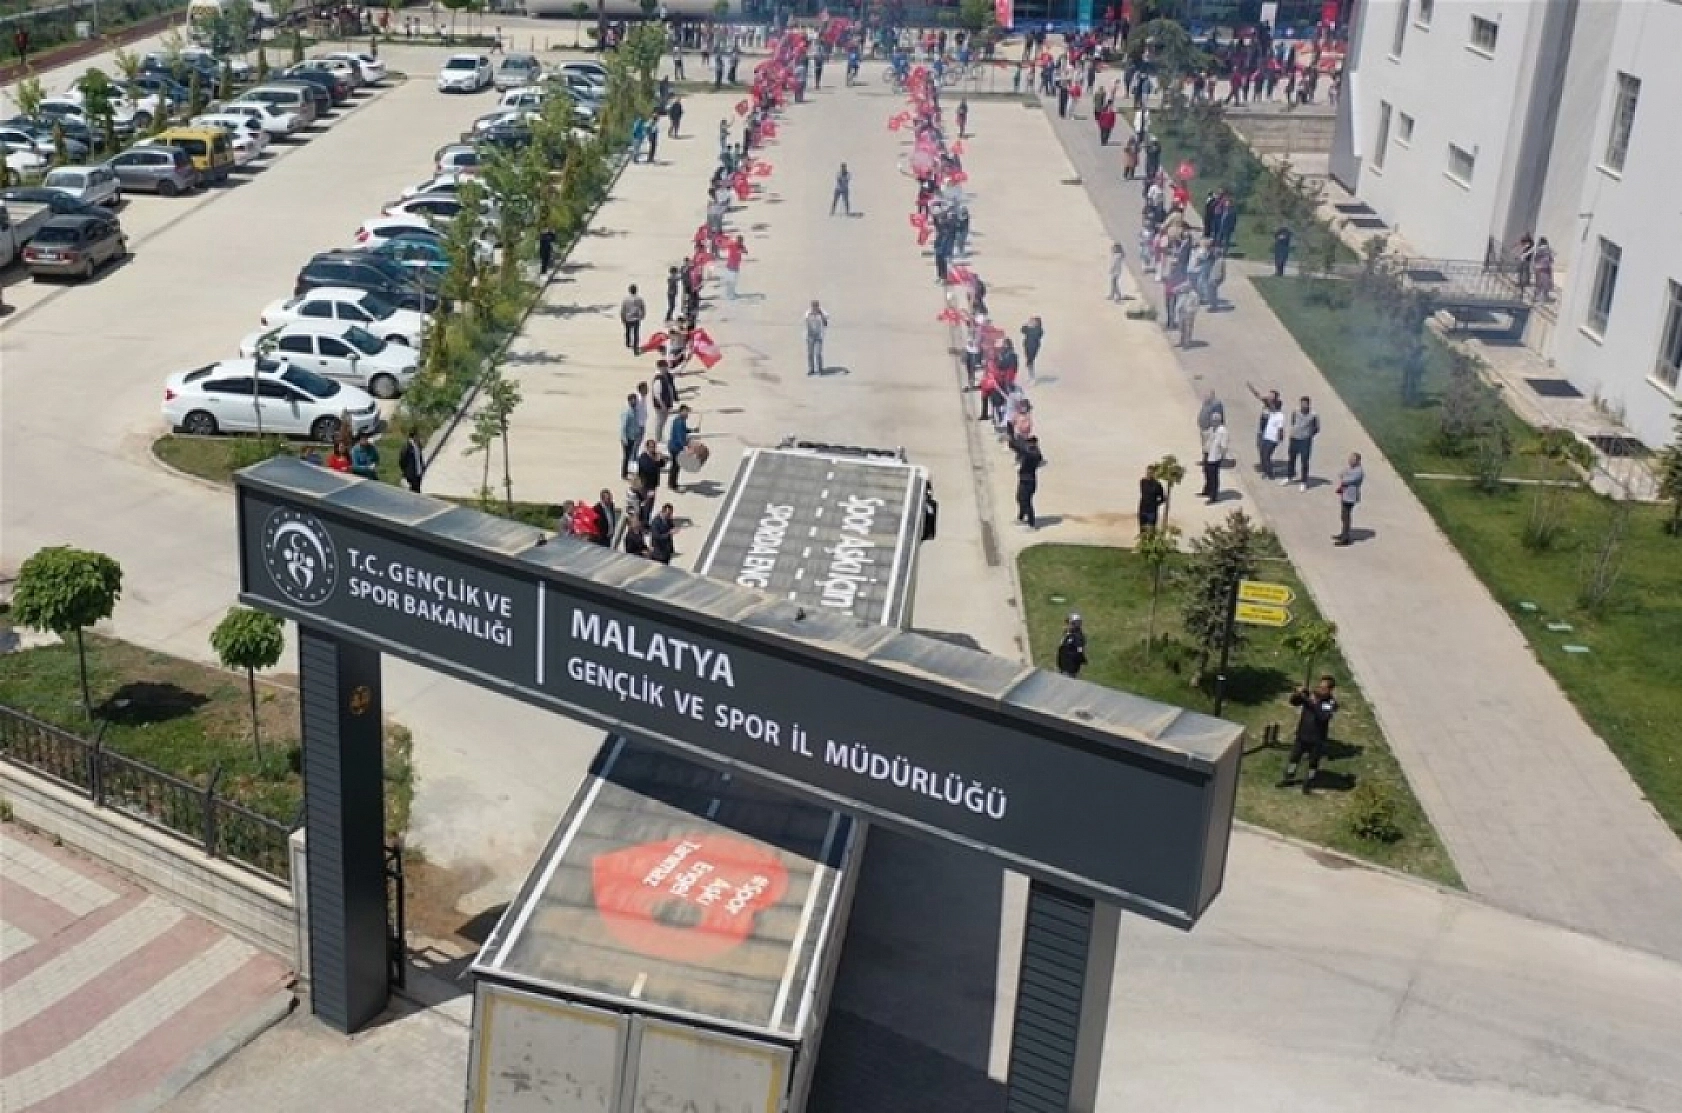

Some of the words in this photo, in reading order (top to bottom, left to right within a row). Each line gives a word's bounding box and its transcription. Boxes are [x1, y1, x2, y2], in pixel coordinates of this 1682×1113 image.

[347, 548, 384, 577] T.C.
[388, 562, 481, 608] GENÇLİK
[484, 591, 513, 618] VE
[348, 578, 400, 610] SPOR
[403, 593, 514, 647] BAKANLIĞI
[571, 608, 735, 687] MALATYA
[567, 657, 665, 708] GENÇLİK
[673, 688, 704, 721] VE
[715, 704, 781, 747] SPOR
[791, 722, 814, 757] İL
[824, 739, 1007, 819] MÜDÜRLÜĞÜ
